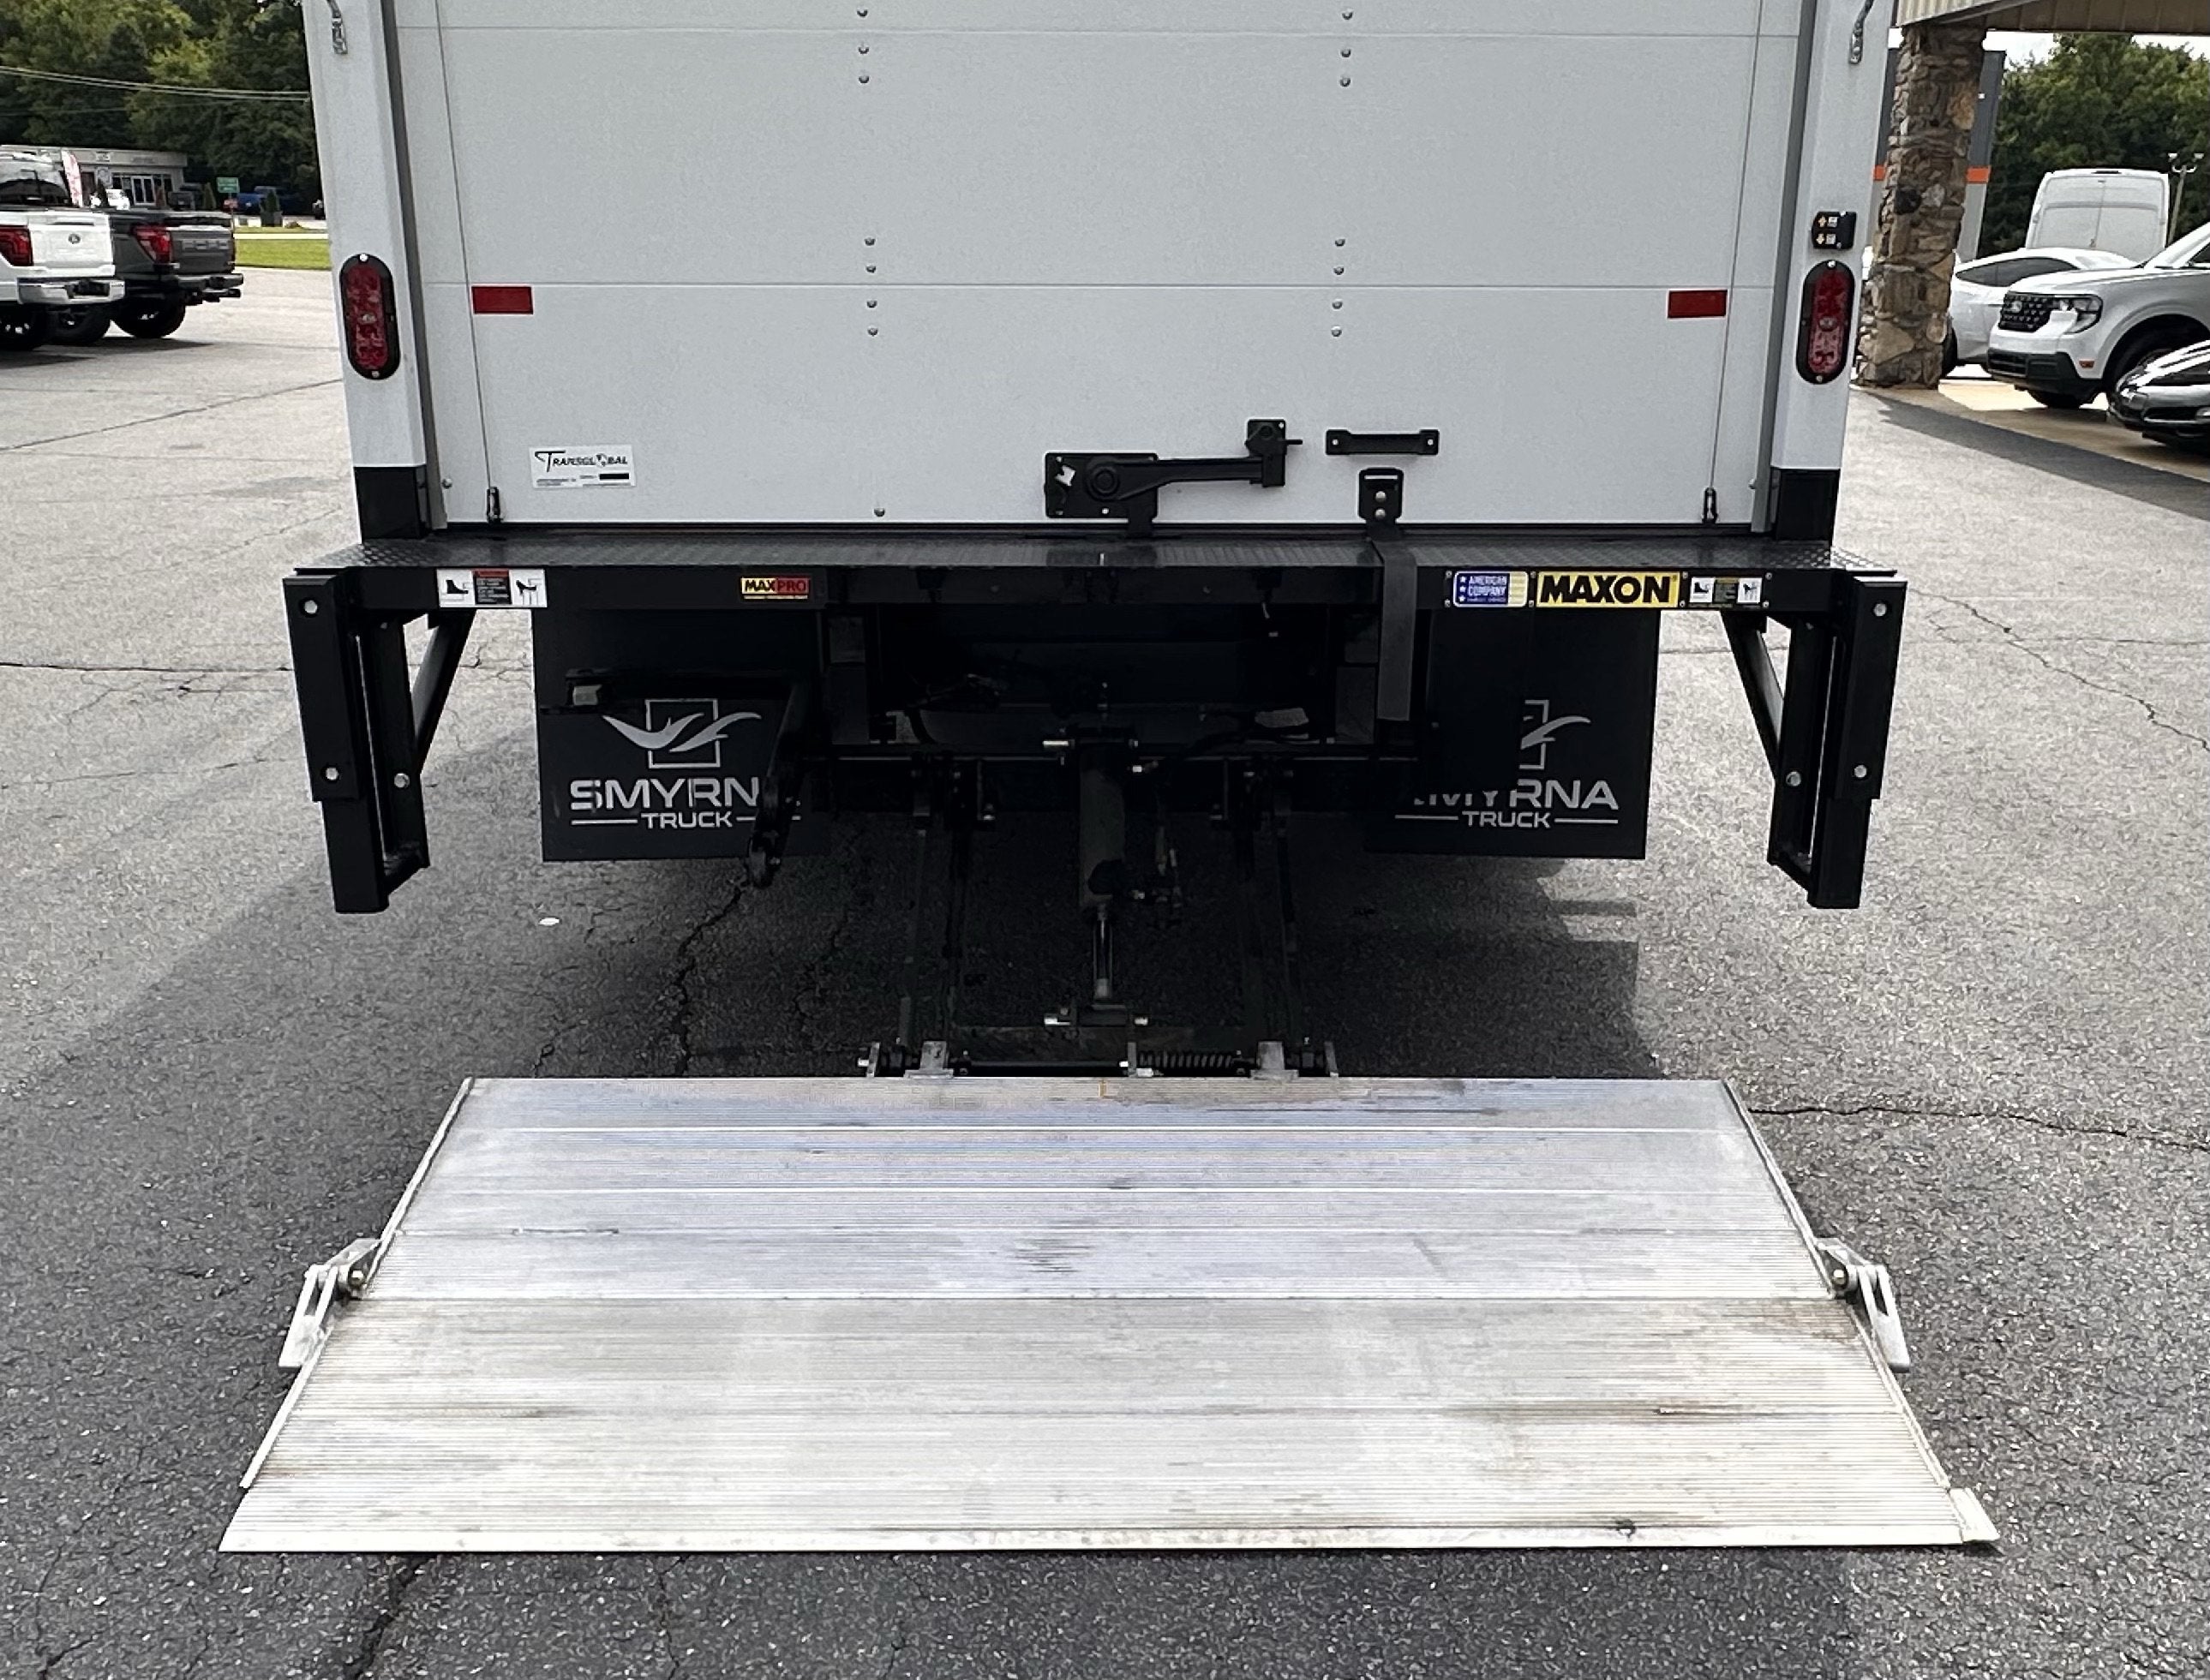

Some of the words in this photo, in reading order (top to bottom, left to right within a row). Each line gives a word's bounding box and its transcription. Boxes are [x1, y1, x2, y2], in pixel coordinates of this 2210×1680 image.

[745, 579, 806, 591] MAXPRO
[1467, 586, 1507, 596] COMPANY
[1540, 575, 1672, 604] MAXON
[570, 776, 801, 810] SMYRN
[1413, 778, 1620, 810] YRNA
[640, 810, 734, 829] TRUCK
[1461, 810, 1551, 829] TRUCK
